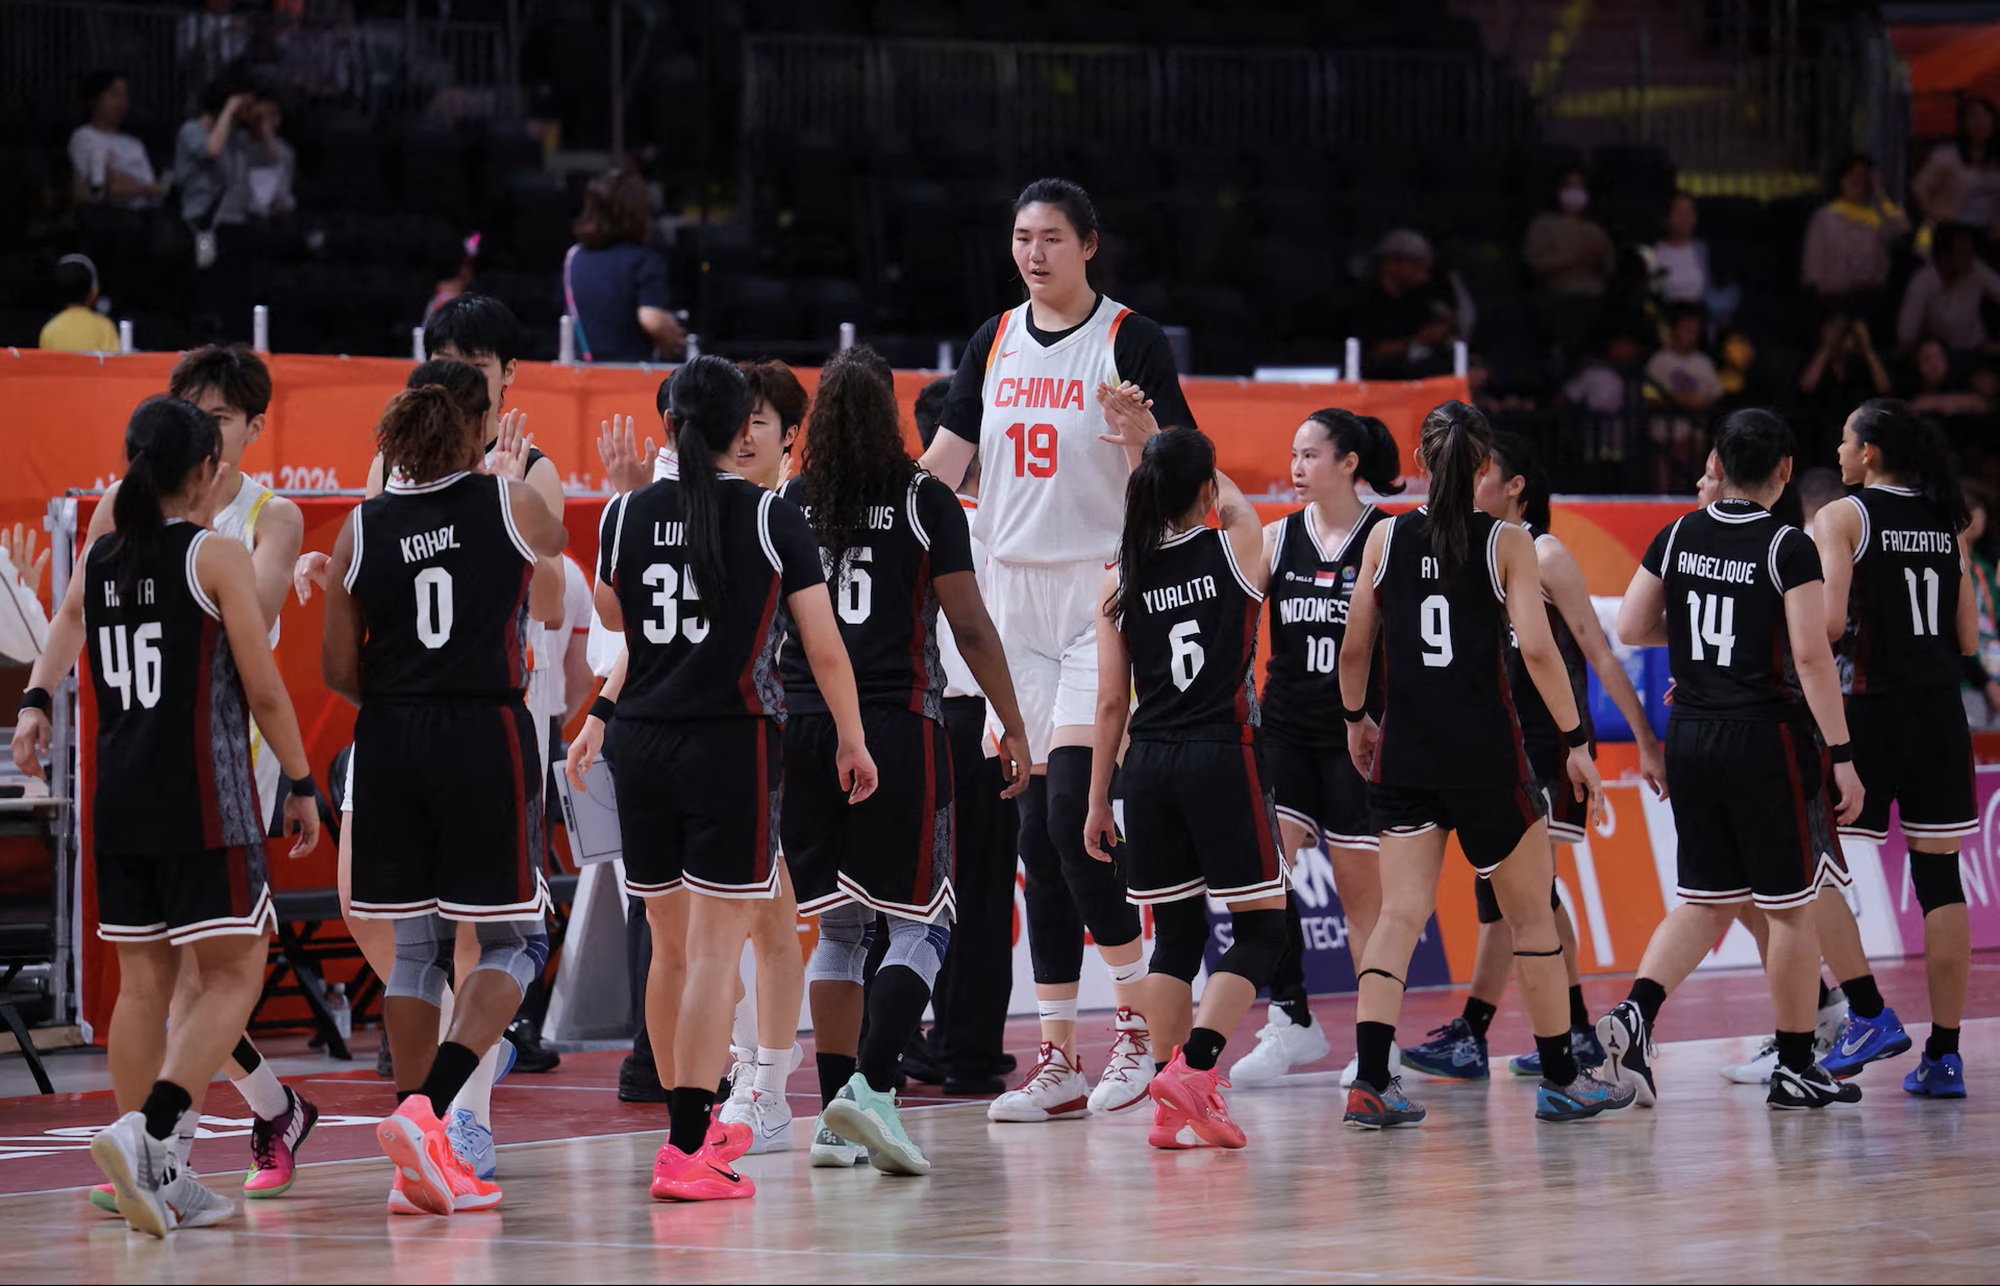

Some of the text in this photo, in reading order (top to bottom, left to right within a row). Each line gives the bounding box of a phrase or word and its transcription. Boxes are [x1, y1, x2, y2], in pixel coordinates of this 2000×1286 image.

[994, 378, 1084, 410] CHINA
[1005, 423, 1058, 478] 19
[400, 524, 461, 563] KAHOL
[1881, 529, 1952, 555] FAIZZATUS
[1677, 551, 1757, 585] ANGELIQUE
[414, 566, 454, 649] 0
[1142, 574, 1217, 614] YUALITA
[1280, 597, 1350, 625] INDONES
[1904, 567, 1940, 636] 11
[1420, 594, 1454, 667] 9
[1686, 590, 1736, 667] 14
[99, 622, 162, 711] 46
[1168, 619, 1205, 693] 6
[1306, 635, 1336, 674] 10
